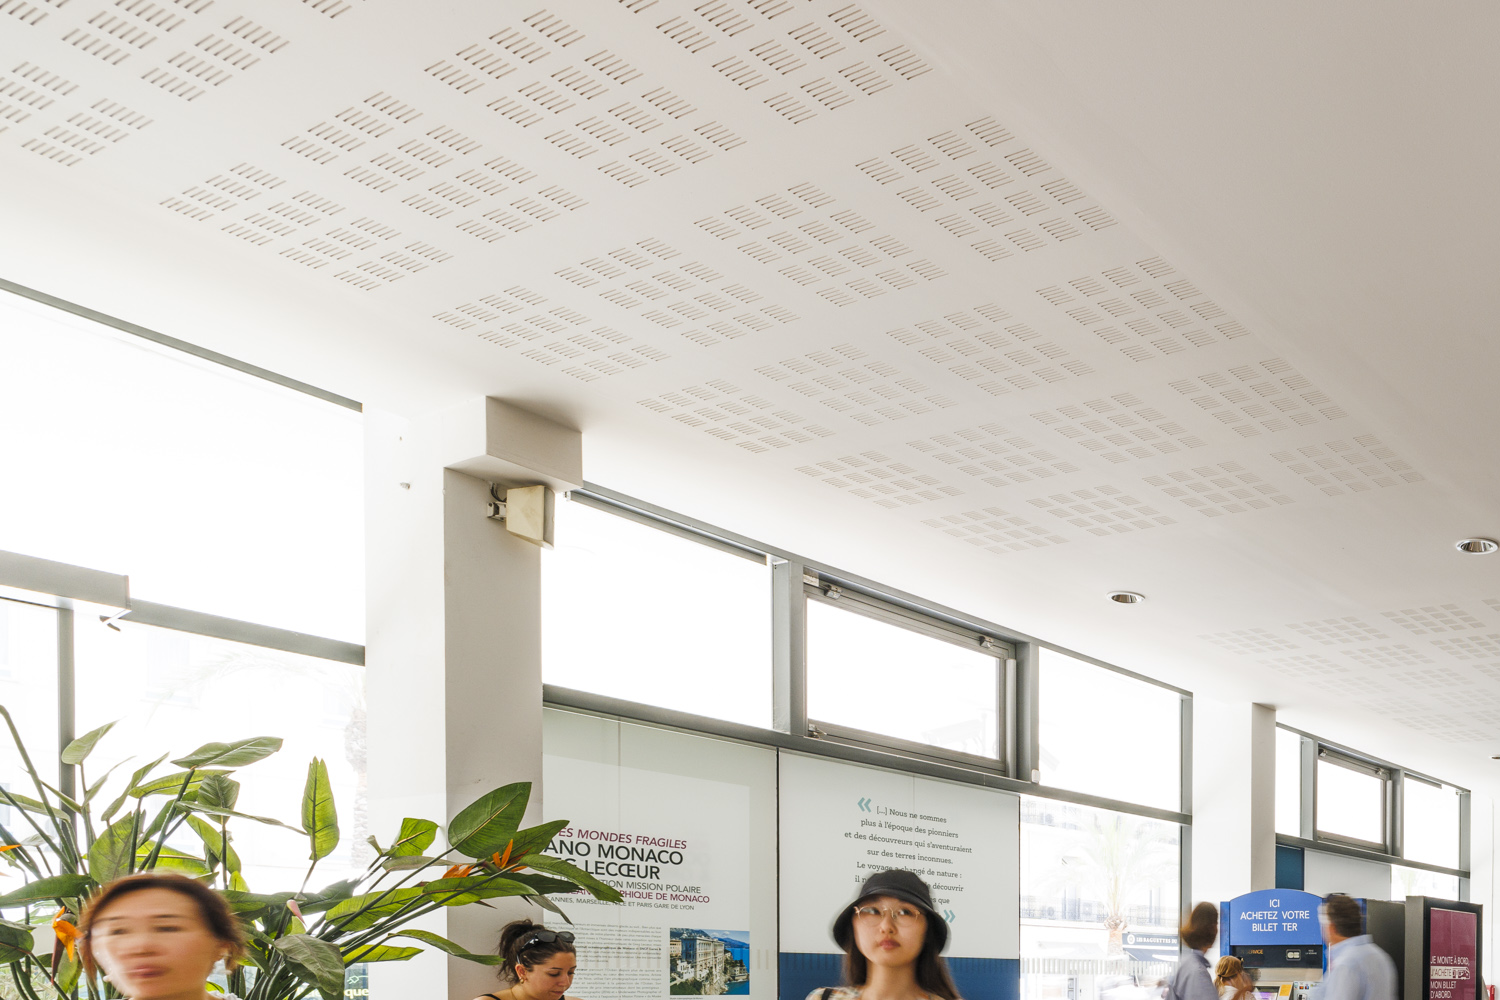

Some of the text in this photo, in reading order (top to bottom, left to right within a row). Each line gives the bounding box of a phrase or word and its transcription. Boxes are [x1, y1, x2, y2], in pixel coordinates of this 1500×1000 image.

[890, 809, 907, 817] Nous
[920, 814, 947, 823] sommes
[885, 822, 912, 833] l'époque
[928, 828, 958, 838] pionniers
[558, 827, 687, 849] ES MONDES FRAGILES
[854, 832, 866, 840] des
[869, 834, 912, 846] découvreurs
[915, 840, 925, 848] qui
[927, 841, 972, 854] s'aventuraient
[598, 844, 683, 865] MONACO
[918, 854, 953, 864] inconnues.
[867, 863, 892, 872] voyage
[626, 882, 663, 891] MISSION
[666, 884, 701, 893] POLAIRE
[932, 882, 963, 892] découvrir
[670, 894, 710, 903] MONACO
[1269, 899, 1280, 907] ICI
[1240, 910, 1310, 920] ACHETEZ VOTRE
[1252, 923, 1297, 931] BILLET TER
[1437, 956, 1453, 964] MONTE
[1458, 957, 1470, 966] BORD,
[1443, 981, 1456, 989] BILLET
[1431, 991, 1452, 999] D'ABORD.
